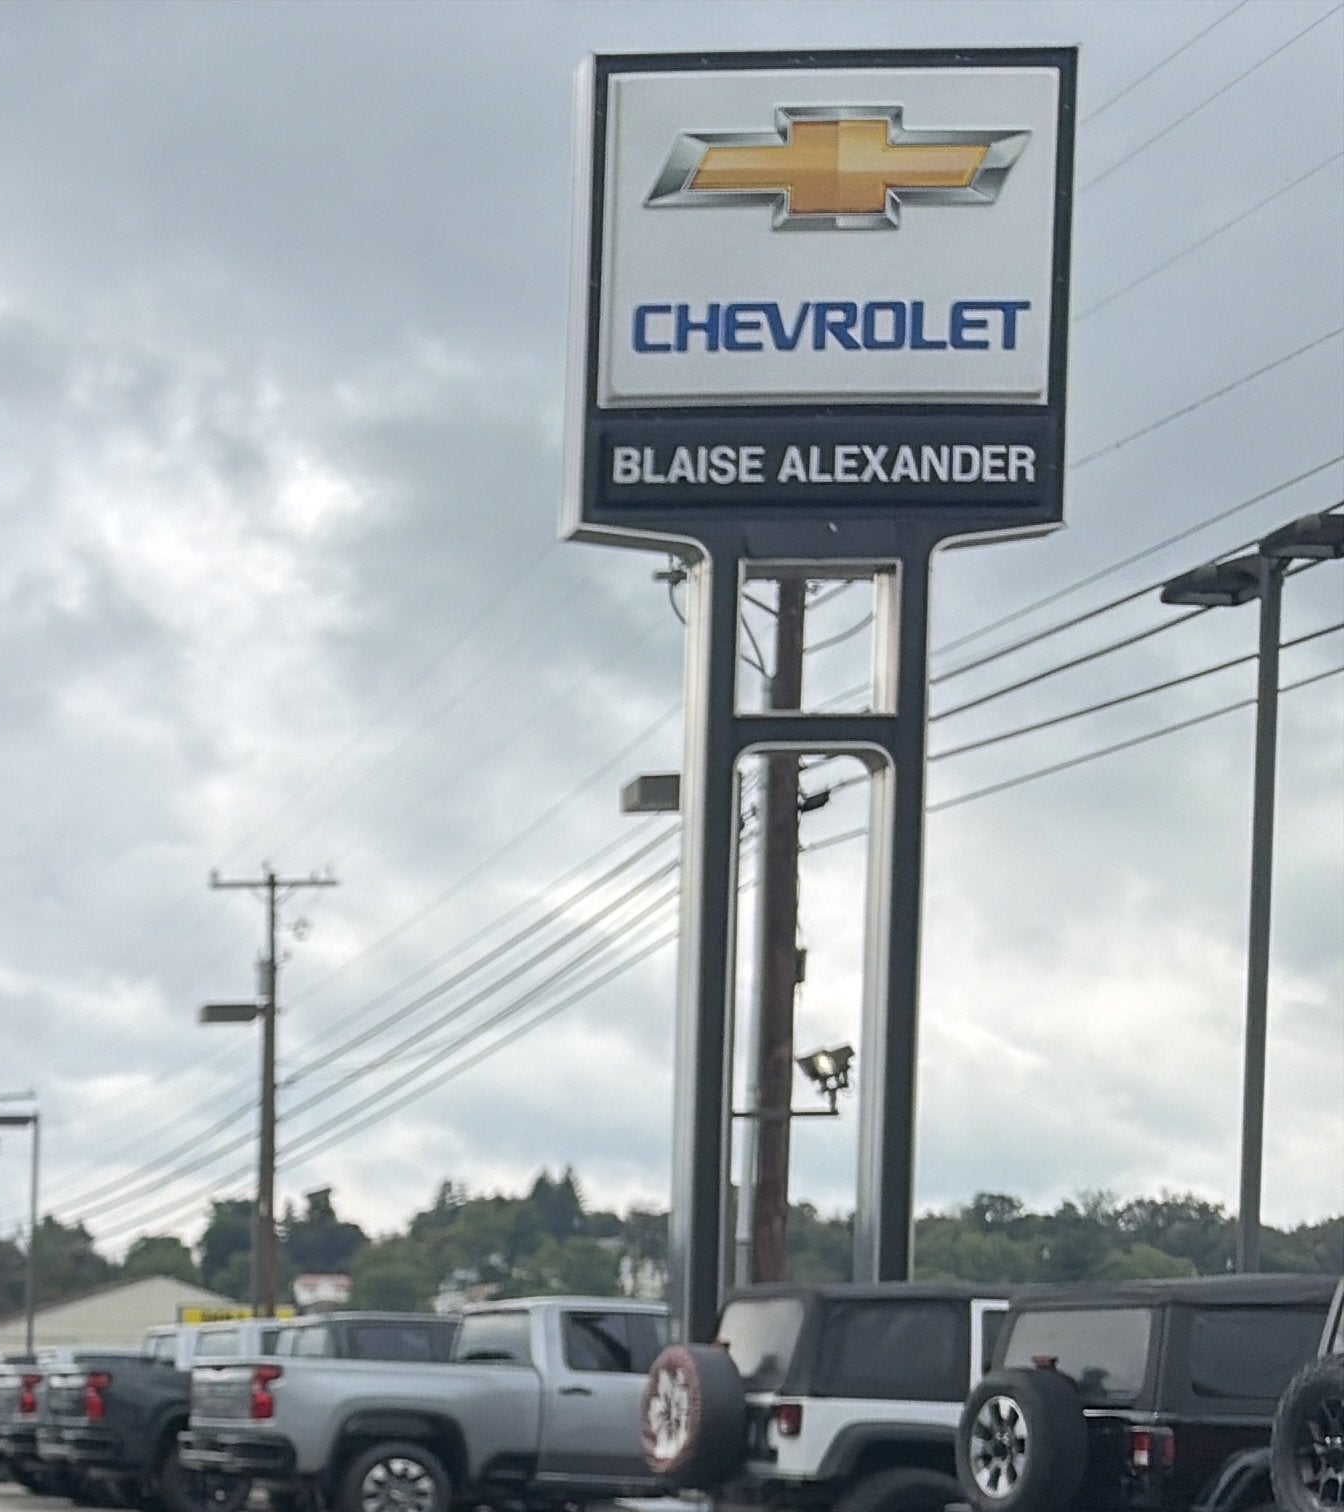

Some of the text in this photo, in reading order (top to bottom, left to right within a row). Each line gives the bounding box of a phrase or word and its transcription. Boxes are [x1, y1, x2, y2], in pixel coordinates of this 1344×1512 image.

[632, 300, 1031, 353] CHEVROLET
[612, 444, 1037, 485] BLAISE ALEXANDER
